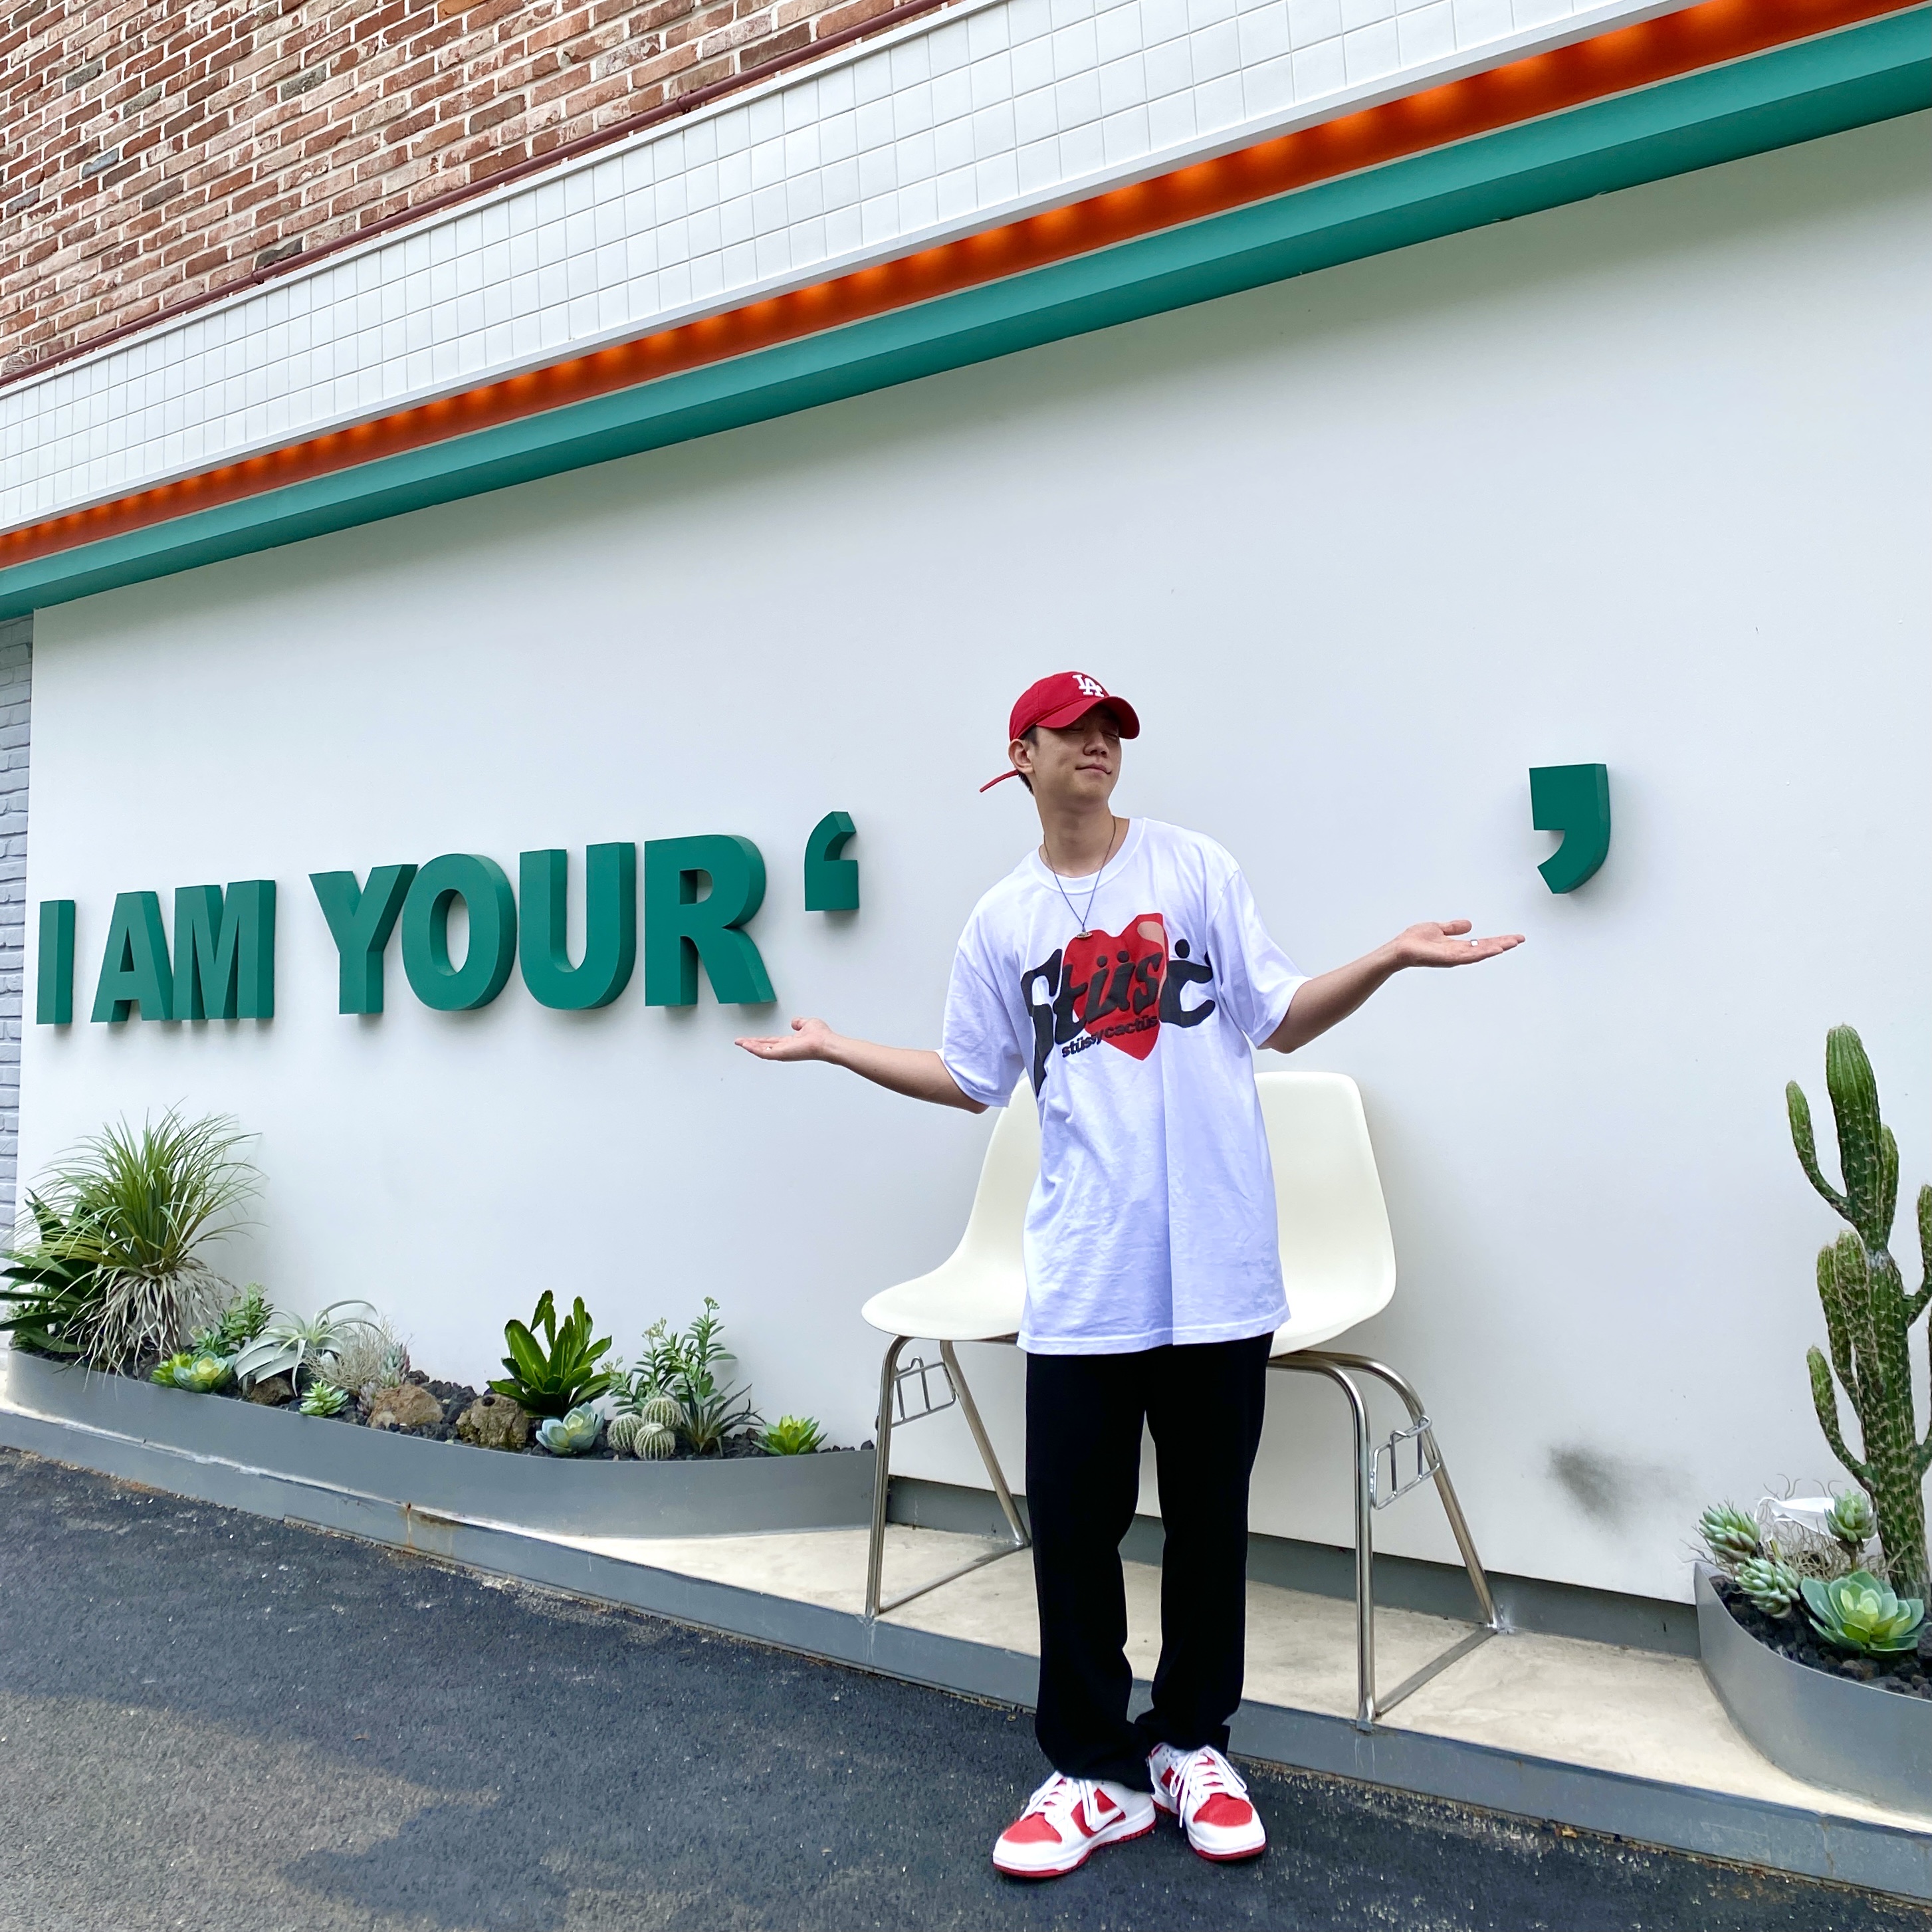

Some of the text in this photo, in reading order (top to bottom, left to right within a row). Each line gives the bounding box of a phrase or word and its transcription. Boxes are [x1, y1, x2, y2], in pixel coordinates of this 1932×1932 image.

[1072, 674, 1105, 698] LA
[37, 901, 75, 1025] I
[91, 879, 276, 1022] AM
[309, 834, 777, 1014] YOUR
